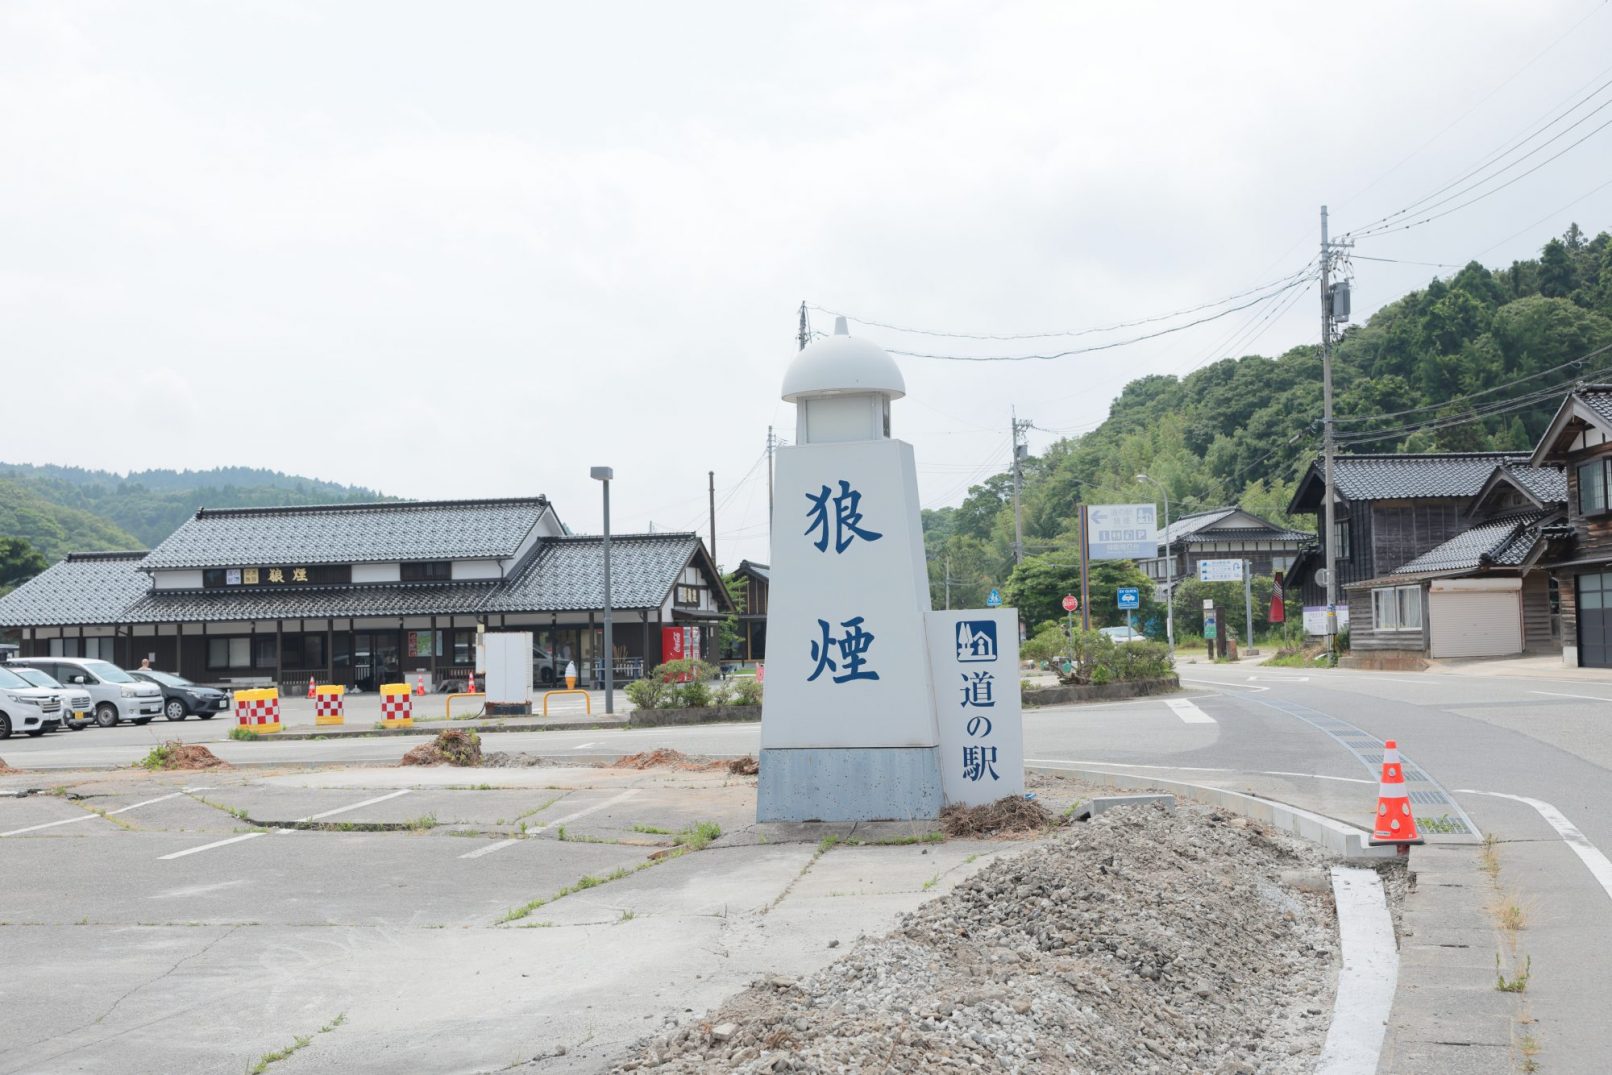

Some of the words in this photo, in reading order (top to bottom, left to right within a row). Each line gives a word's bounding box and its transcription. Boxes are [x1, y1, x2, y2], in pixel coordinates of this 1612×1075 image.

[804, 479, 883, 683] 狼煙
[959, 670, 1000, 782] 道の駅
